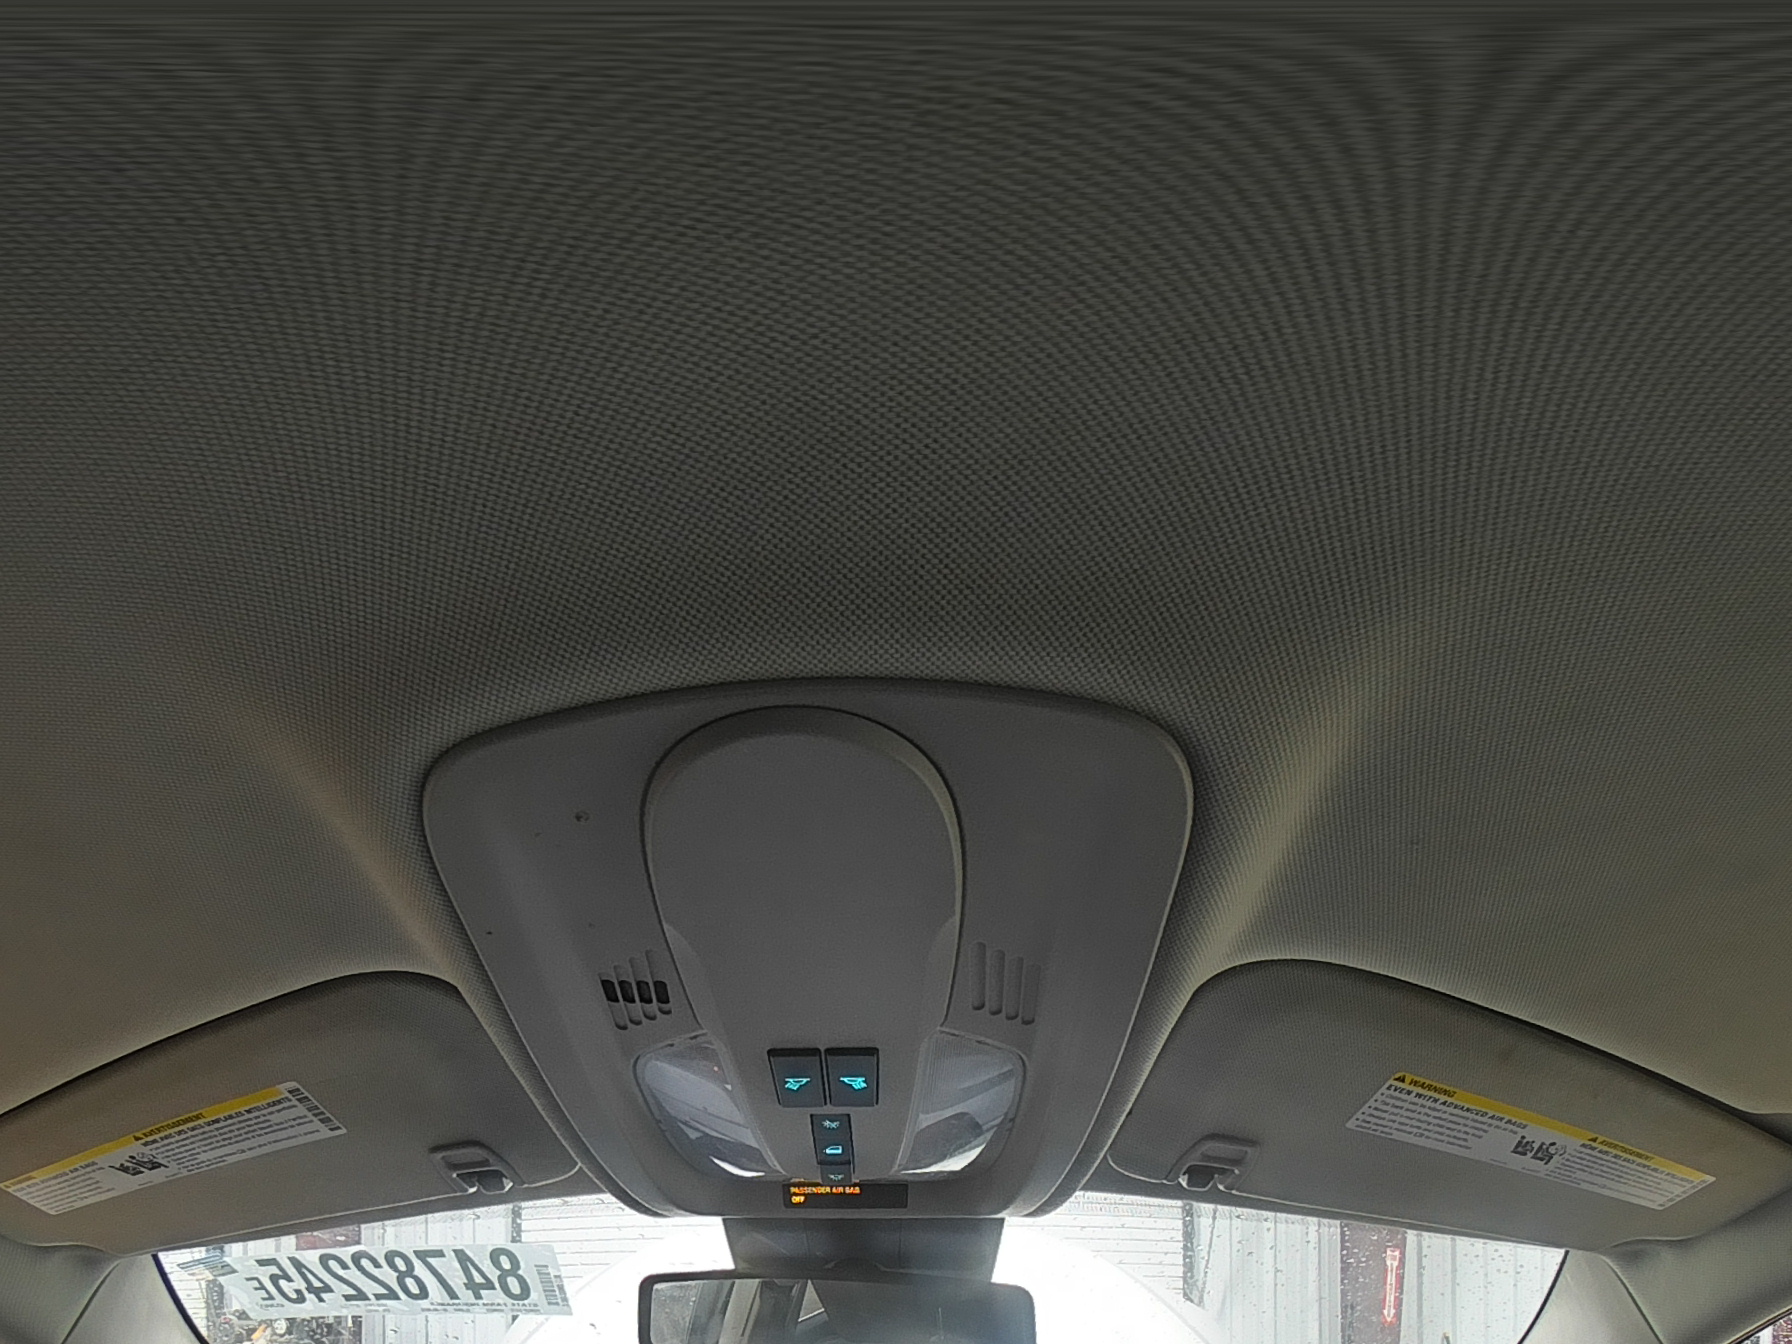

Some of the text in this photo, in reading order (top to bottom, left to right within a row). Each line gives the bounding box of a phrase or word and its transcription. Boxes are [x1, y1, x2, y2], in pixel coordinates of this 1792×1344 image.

[1408, 1078, 1457, 1098] WARNING
[1385, 1084, 1529, 1130] EVEN WITH ADVANCED AIR BAGS
[790, 1186, 831, 1194] PASSENGER
[832, 1186, 845, 1194] AIR
[791, 1196, 805, 1204] OFF
